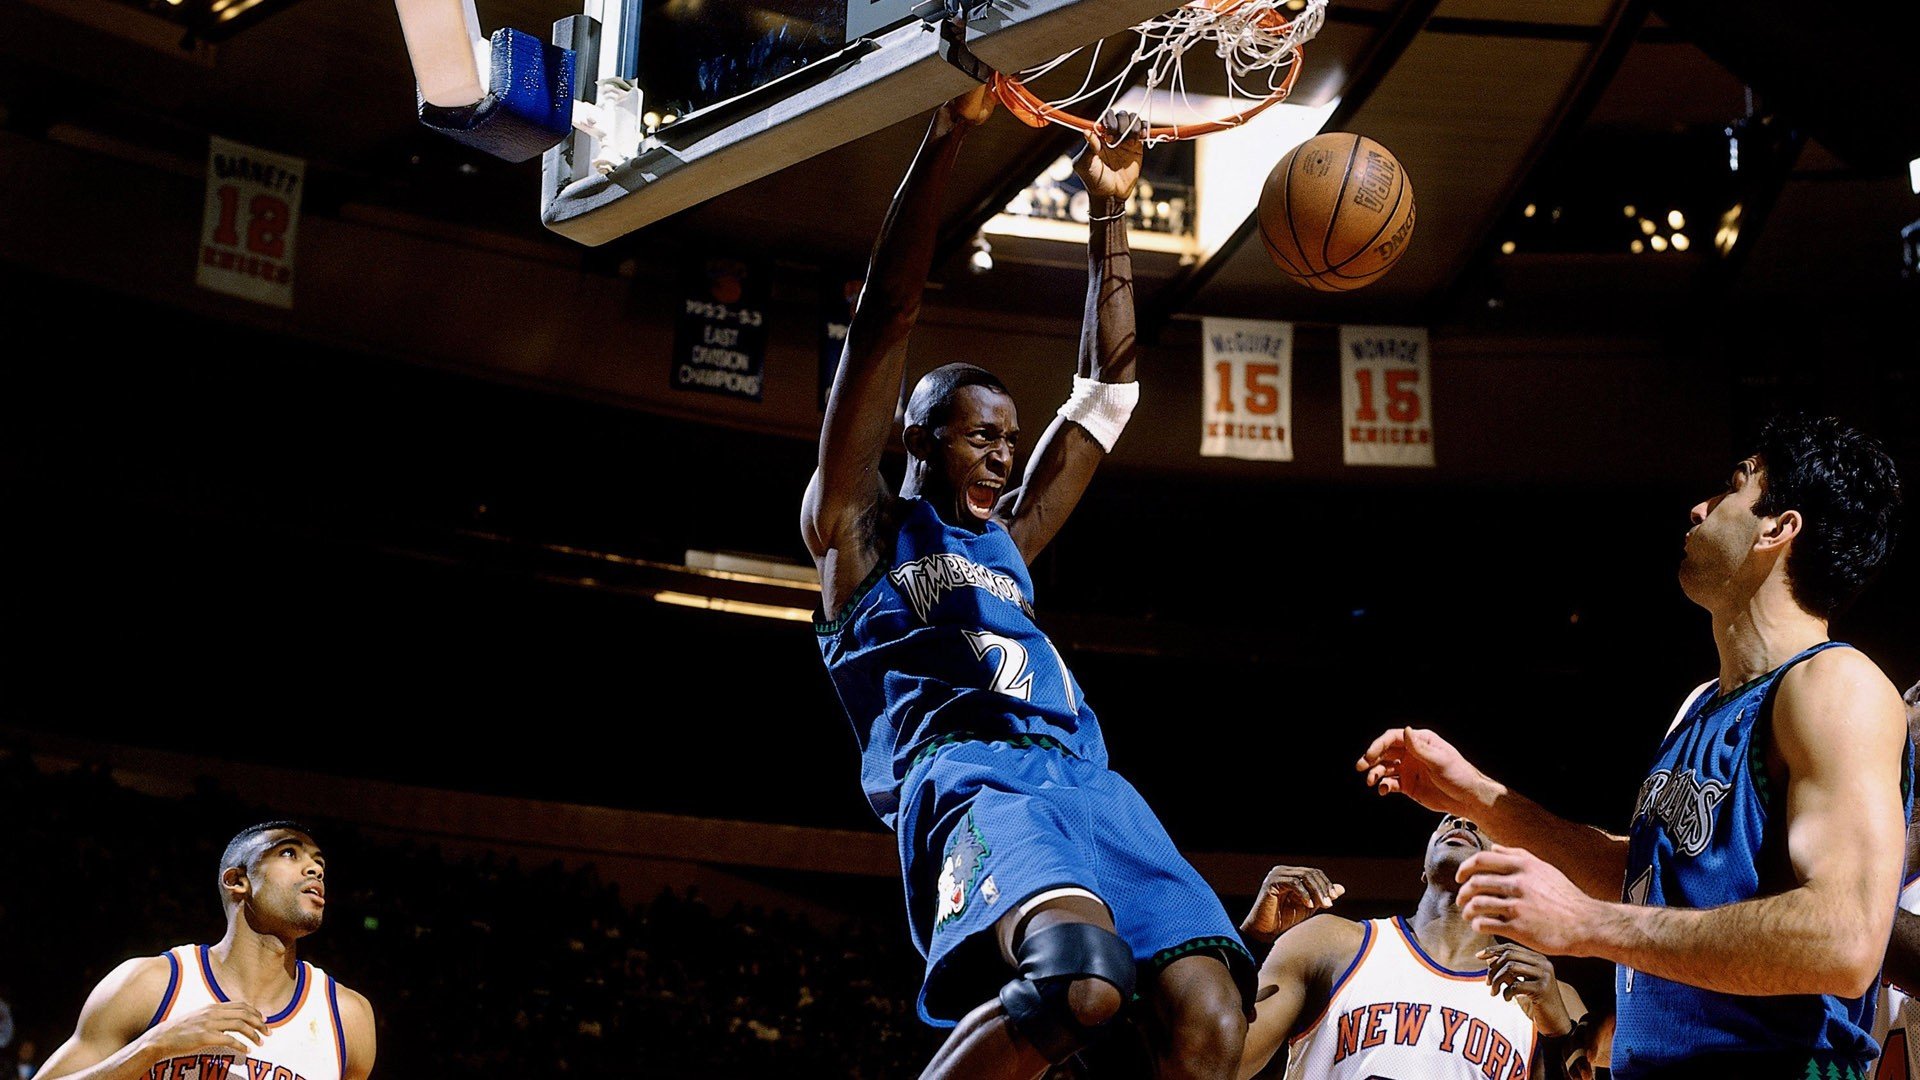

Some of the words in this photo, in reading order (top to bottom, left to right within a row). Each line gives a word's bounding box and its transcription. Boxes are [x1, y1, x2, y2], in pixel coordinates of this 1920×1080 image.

[1350, 338, 1419, 364] MONROE
[1214, 360, 1280, 416] 15
[1355, 368, 1422, 423] 15
[1207, 422, 1286, 443] KNICKS
[1350, 426, 1430, 445] KNICKS
[889, 553, 1036, 624] TIMBERWOL
[1333, 1001, 1431, 1065] NEW
